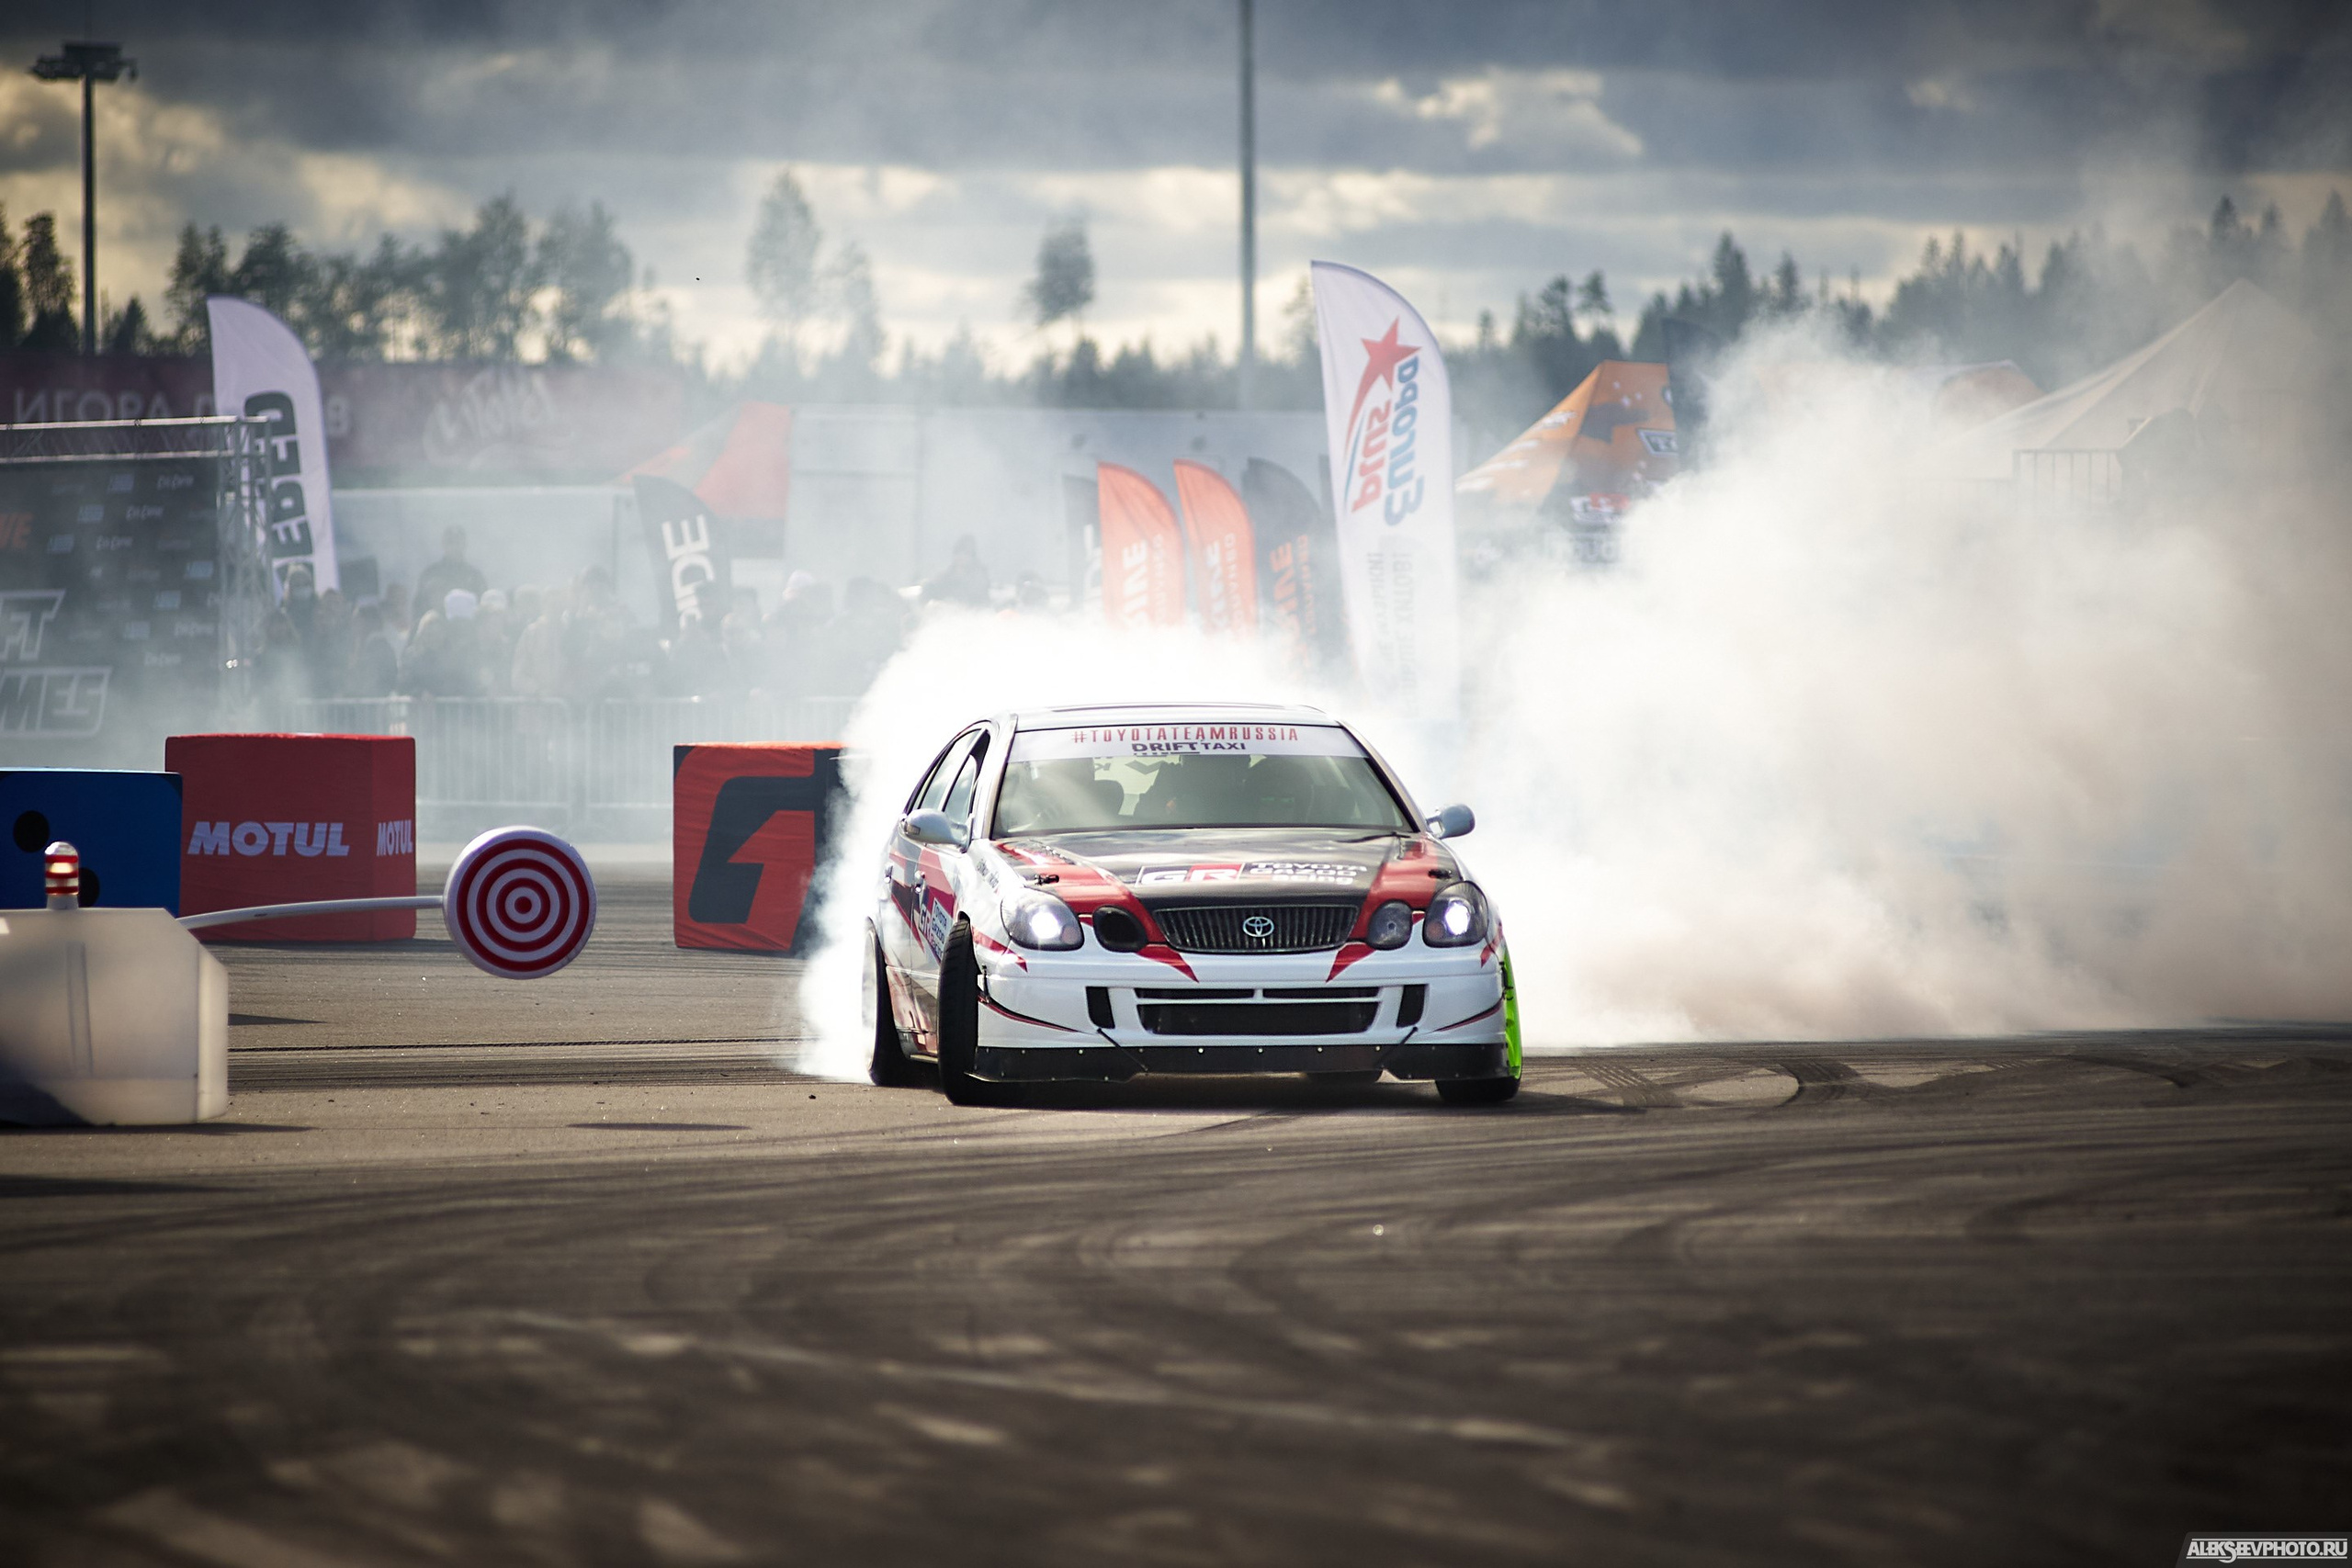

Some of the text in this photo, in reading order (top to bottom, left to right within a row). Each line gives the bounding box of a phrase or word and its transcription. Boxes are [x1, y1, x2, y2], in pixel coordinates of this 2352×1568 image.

[1070, 727, 1299, 744] #TOYOTATEAMRUSSIA
[1131, 741, 1247, 752] DRIFT TAXI
[187, 820, 351, 857] MOTUL
[376, 818, 414, 857] MOTUL
[1250, 862, 1368, 873] TOYOTA
[1250, 868, 1358, 877] GAZOO
[1139, 868, 1239, 886] GR
